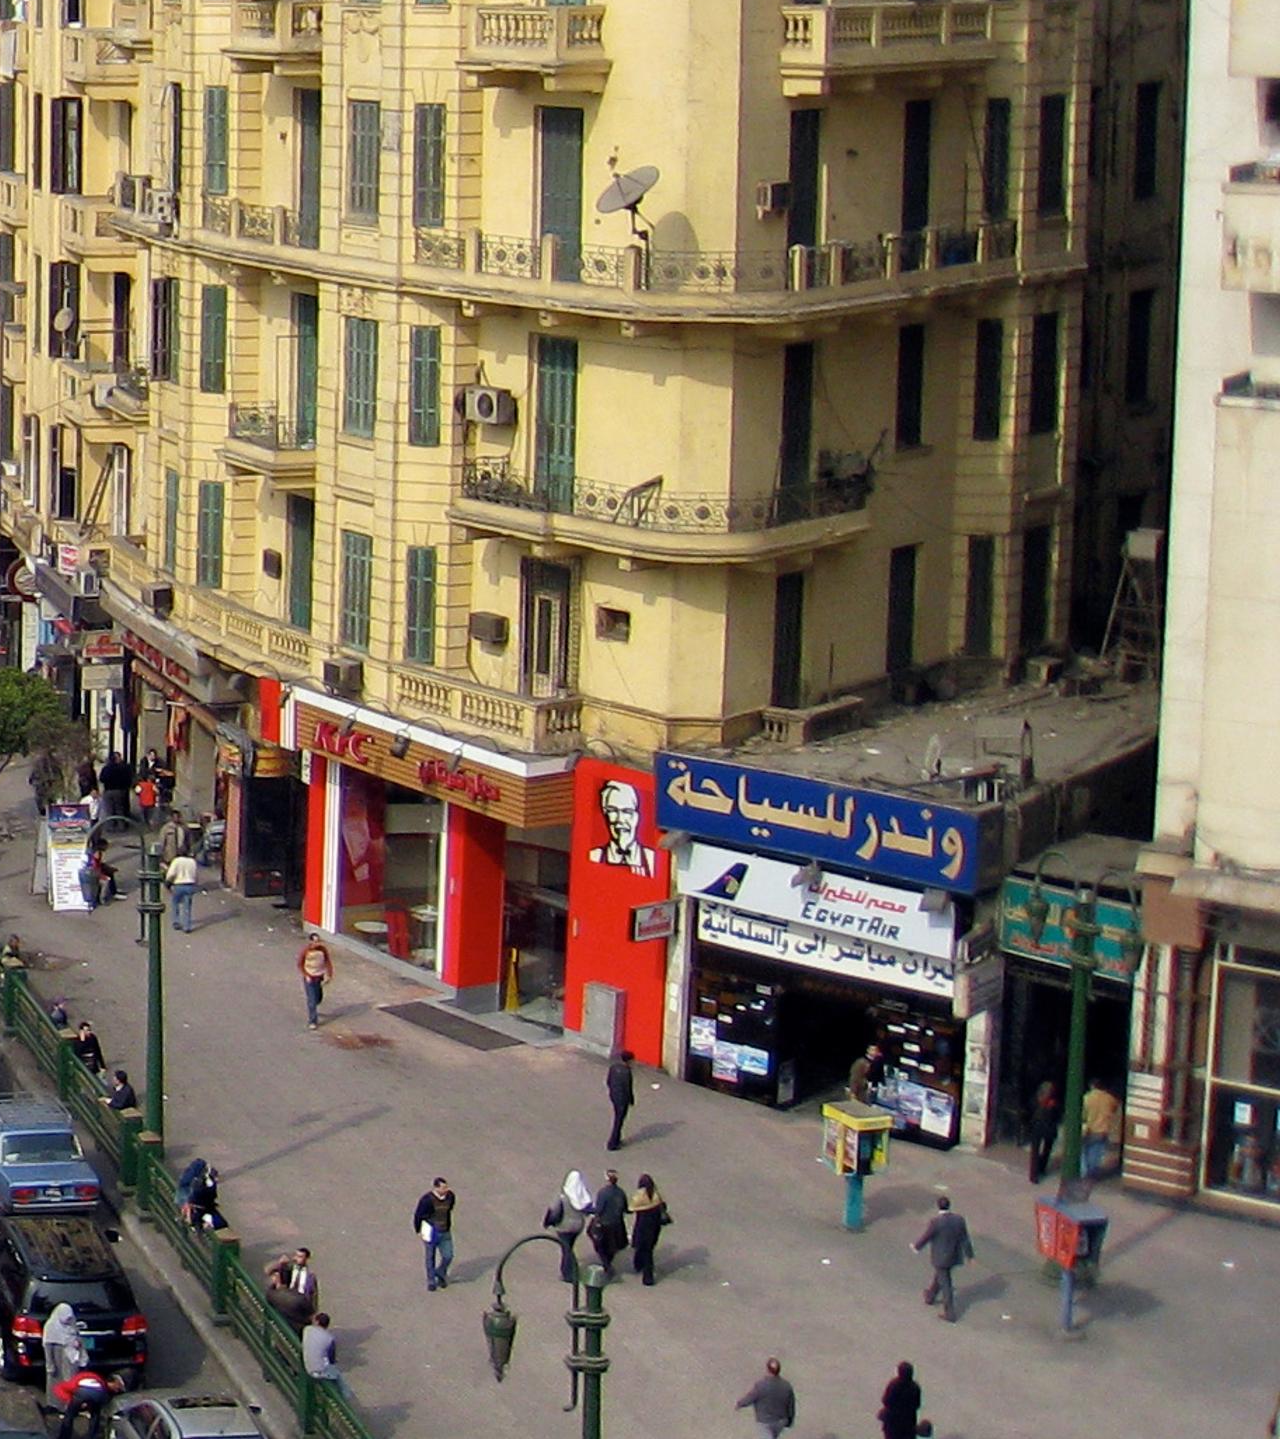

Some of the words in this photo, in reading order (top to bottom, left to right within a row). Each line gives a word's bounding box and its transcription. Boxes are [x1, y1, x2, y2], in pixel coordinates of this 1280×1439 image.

[666, 760, 855, 839] للسياحة
[855, 809, 965, 880] وندر
[864, 898, 907, 913] مصر
